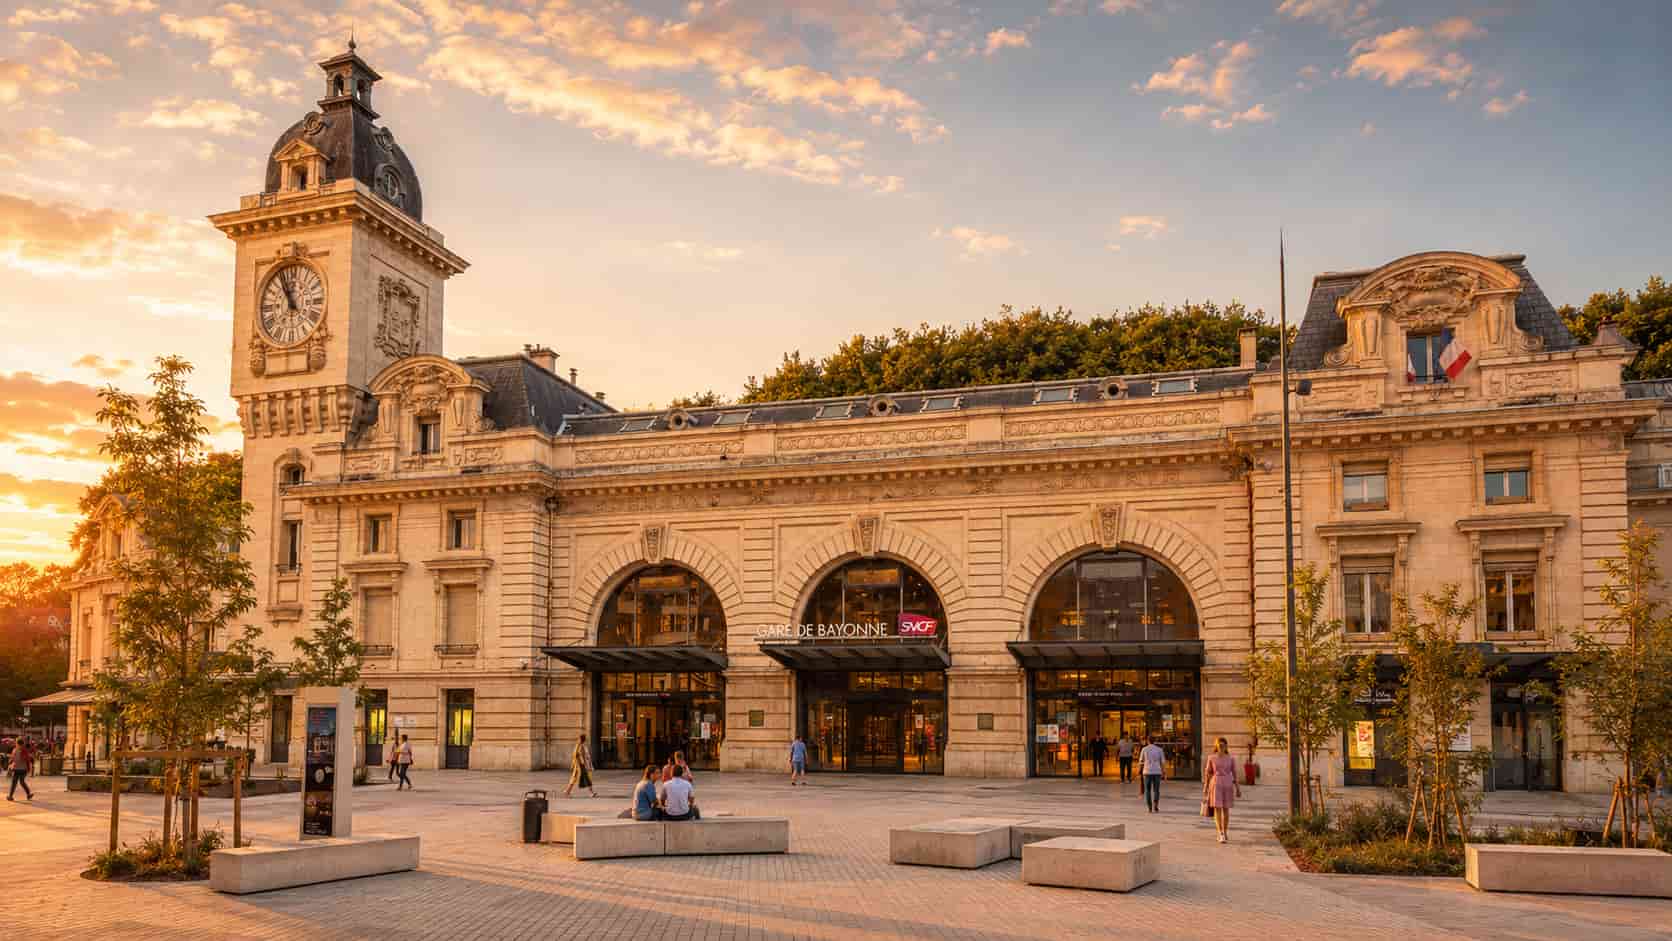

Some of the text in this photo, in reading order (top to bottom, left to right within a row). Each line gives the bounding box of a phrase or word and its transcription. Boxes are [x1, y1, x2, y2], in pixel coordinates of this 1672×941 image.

[758, 622, 888, 637] GARE DE BAYONNE
[901, 620, 936, 633] SNCF
